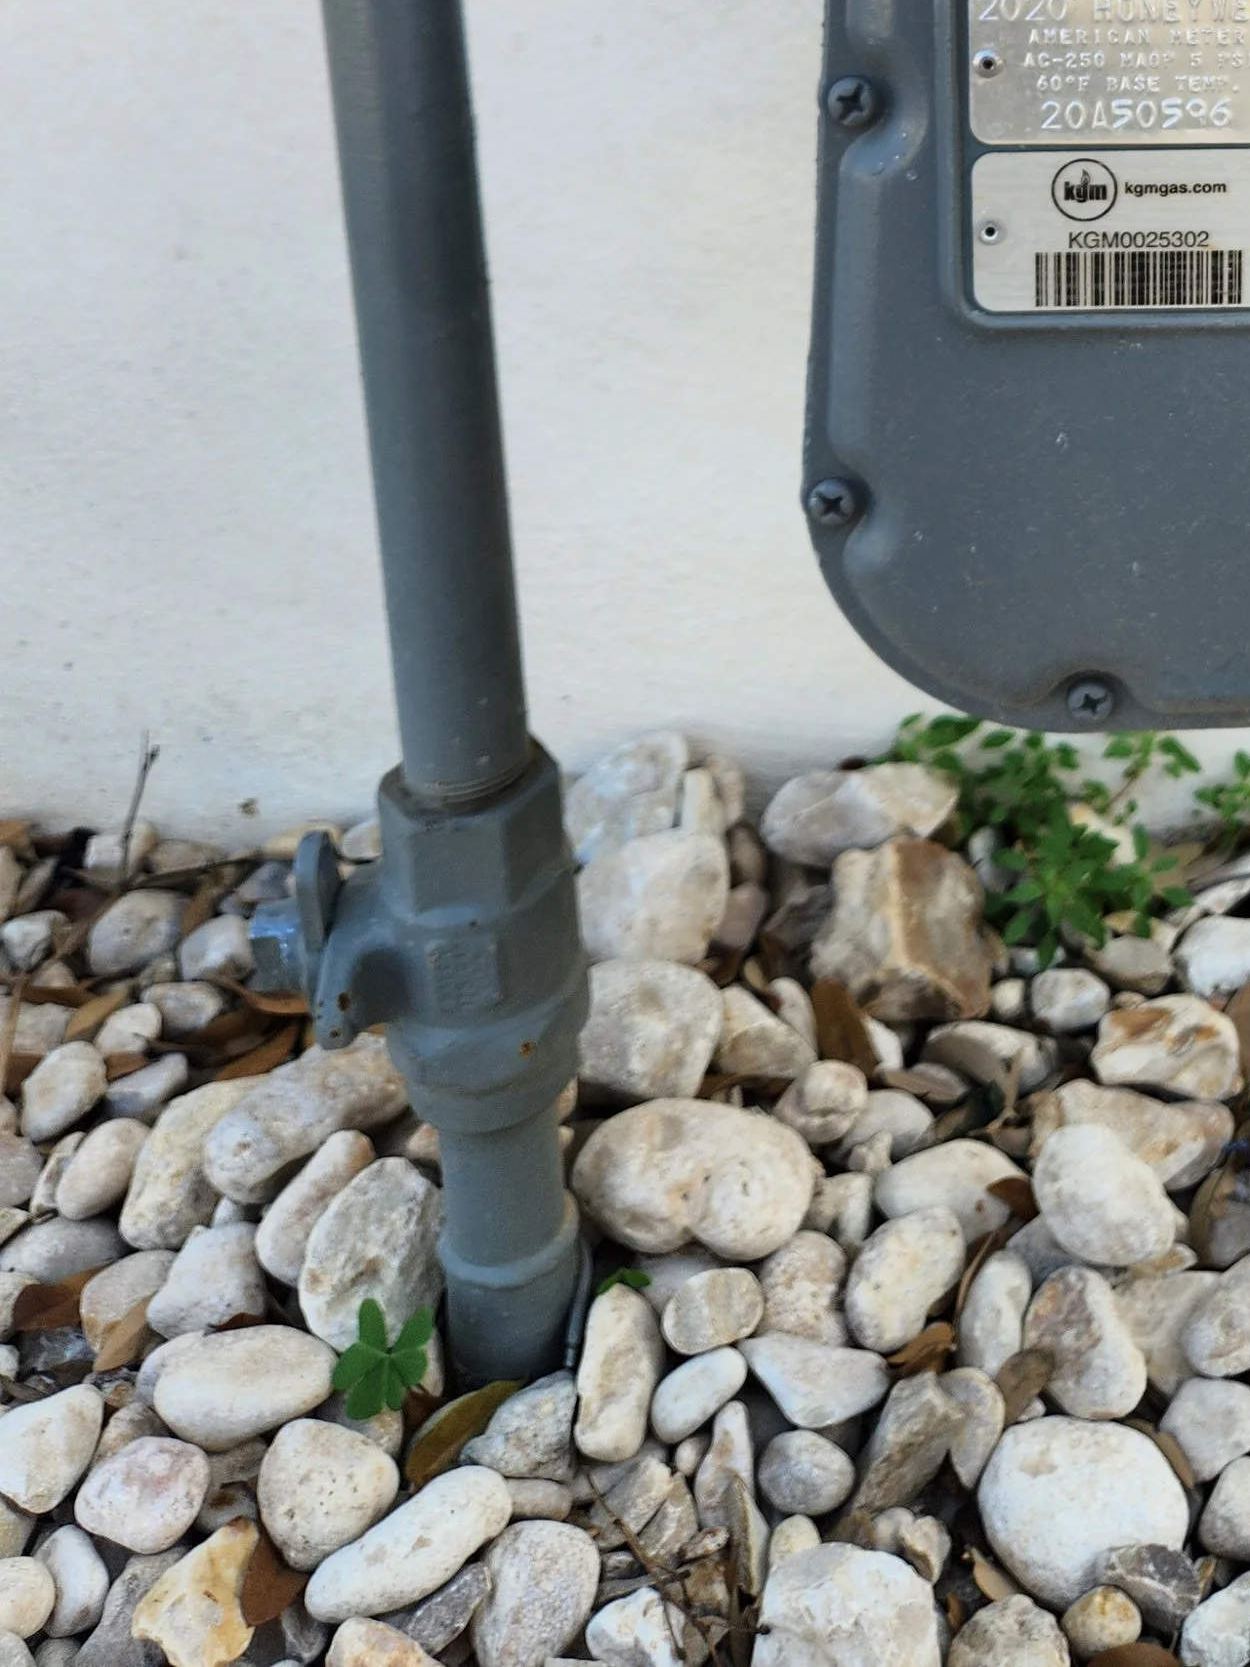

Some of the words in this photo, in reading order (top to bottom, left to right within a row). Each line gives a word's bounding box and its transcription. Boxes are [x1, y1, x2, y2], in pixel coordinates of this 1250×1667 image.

[1028, 28, 1151, 46] AMERICAN
[1169, 28, 1246, 46] METER
[1023, 51, 1106, 69] AC-250
[1190, 51, 1203, 68] 5
[1106, 74, 1161, 92] BASE
[1040, 97, 1234, 130] 20A50596
[1124, 181, 1228, 198] kgmgas.com
[1067, 229, 1211, 250] KGM0025302
